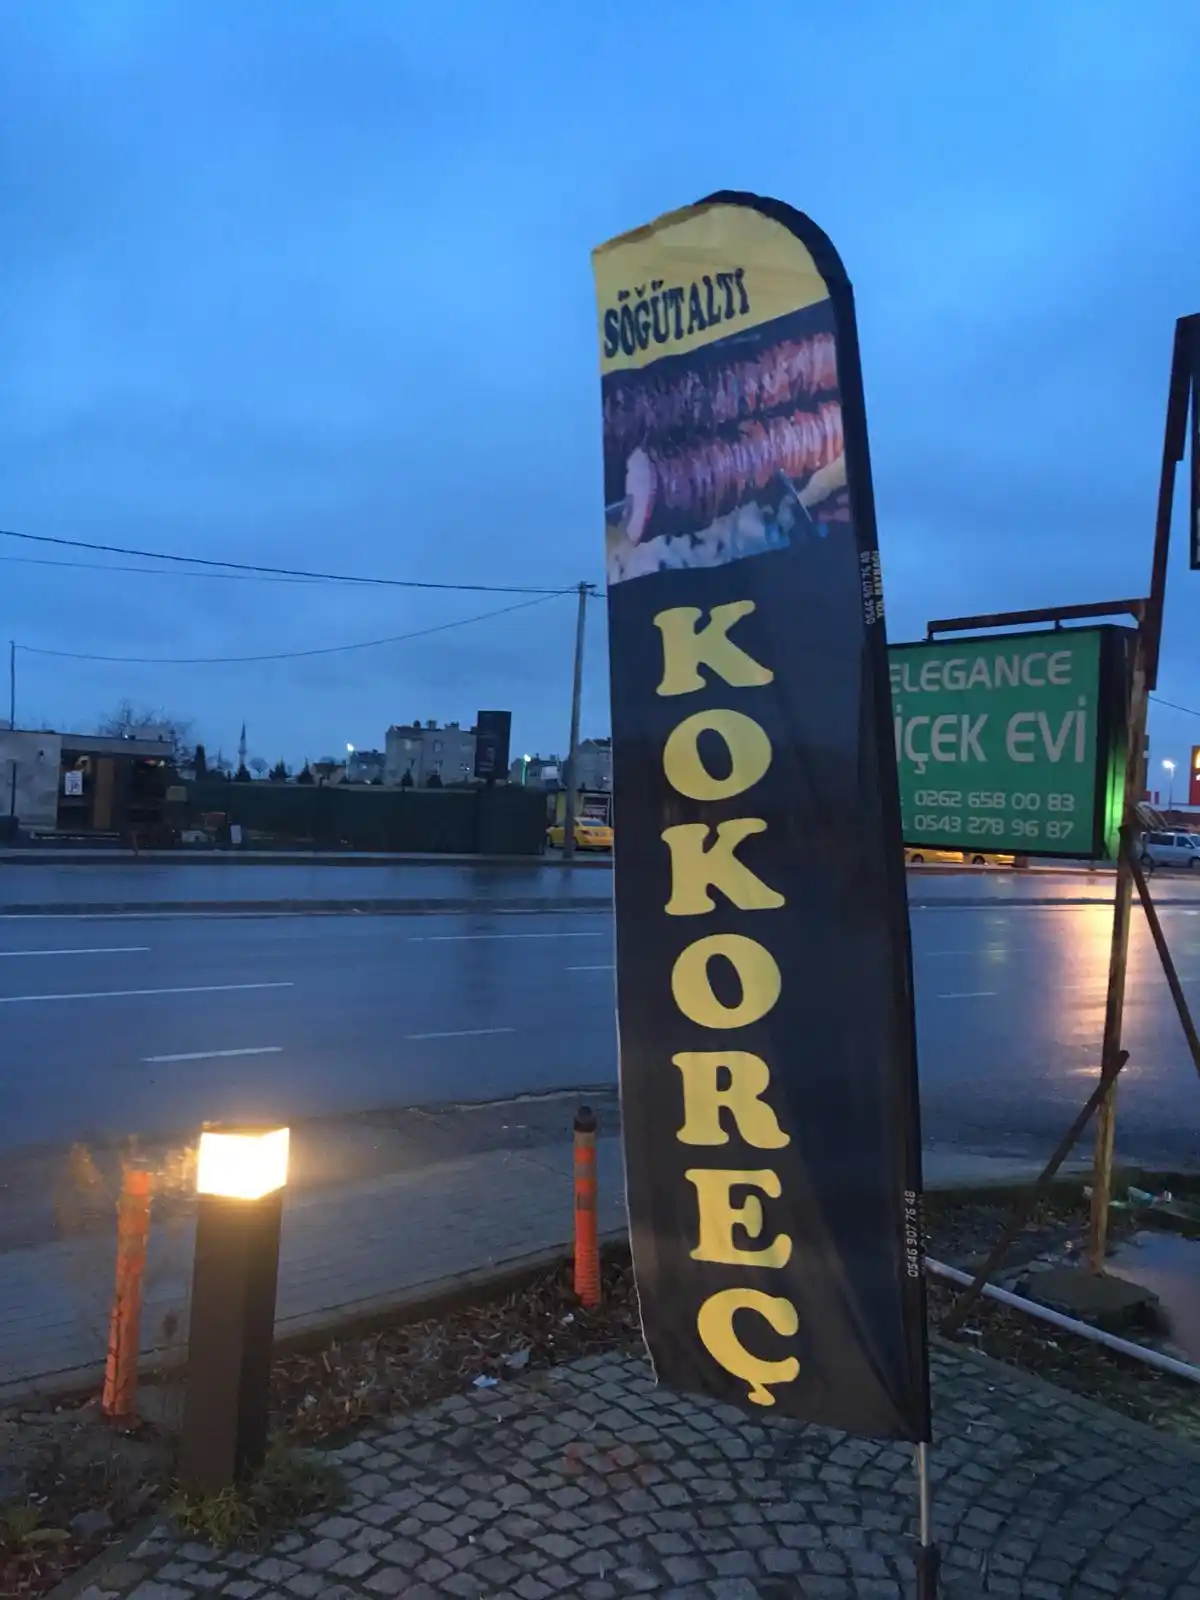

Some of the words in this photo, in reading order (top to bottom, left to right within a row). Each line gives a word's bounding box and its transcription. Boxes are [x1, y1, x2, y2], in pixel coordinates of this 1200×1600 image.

[604, 268, 749, 358] SÖĞÜTALTI
[889, 650, 1072, 694] ELEGANCE
[894, 703, 989, 775] İÇEK
[1006, 695, 1087, 763] EVİ
[914, 790, 963, 808] 0262
[968, 792, 1006, 809] 658
[1011, 792, 1041, 811] 00
[1047, 794, 1075, 812] 83
[914, 815, 961, 833] 0543
[968, 816, 1005, 835] 278
[1011, 819, 1039, 837] 96
[1046, 821, 1074, 839] 87
[653, 599, 801, 1407] KOKOREÇ
[905, 1223, 918, 1246] 907
[907, 1247, 919, 1278] 0546
